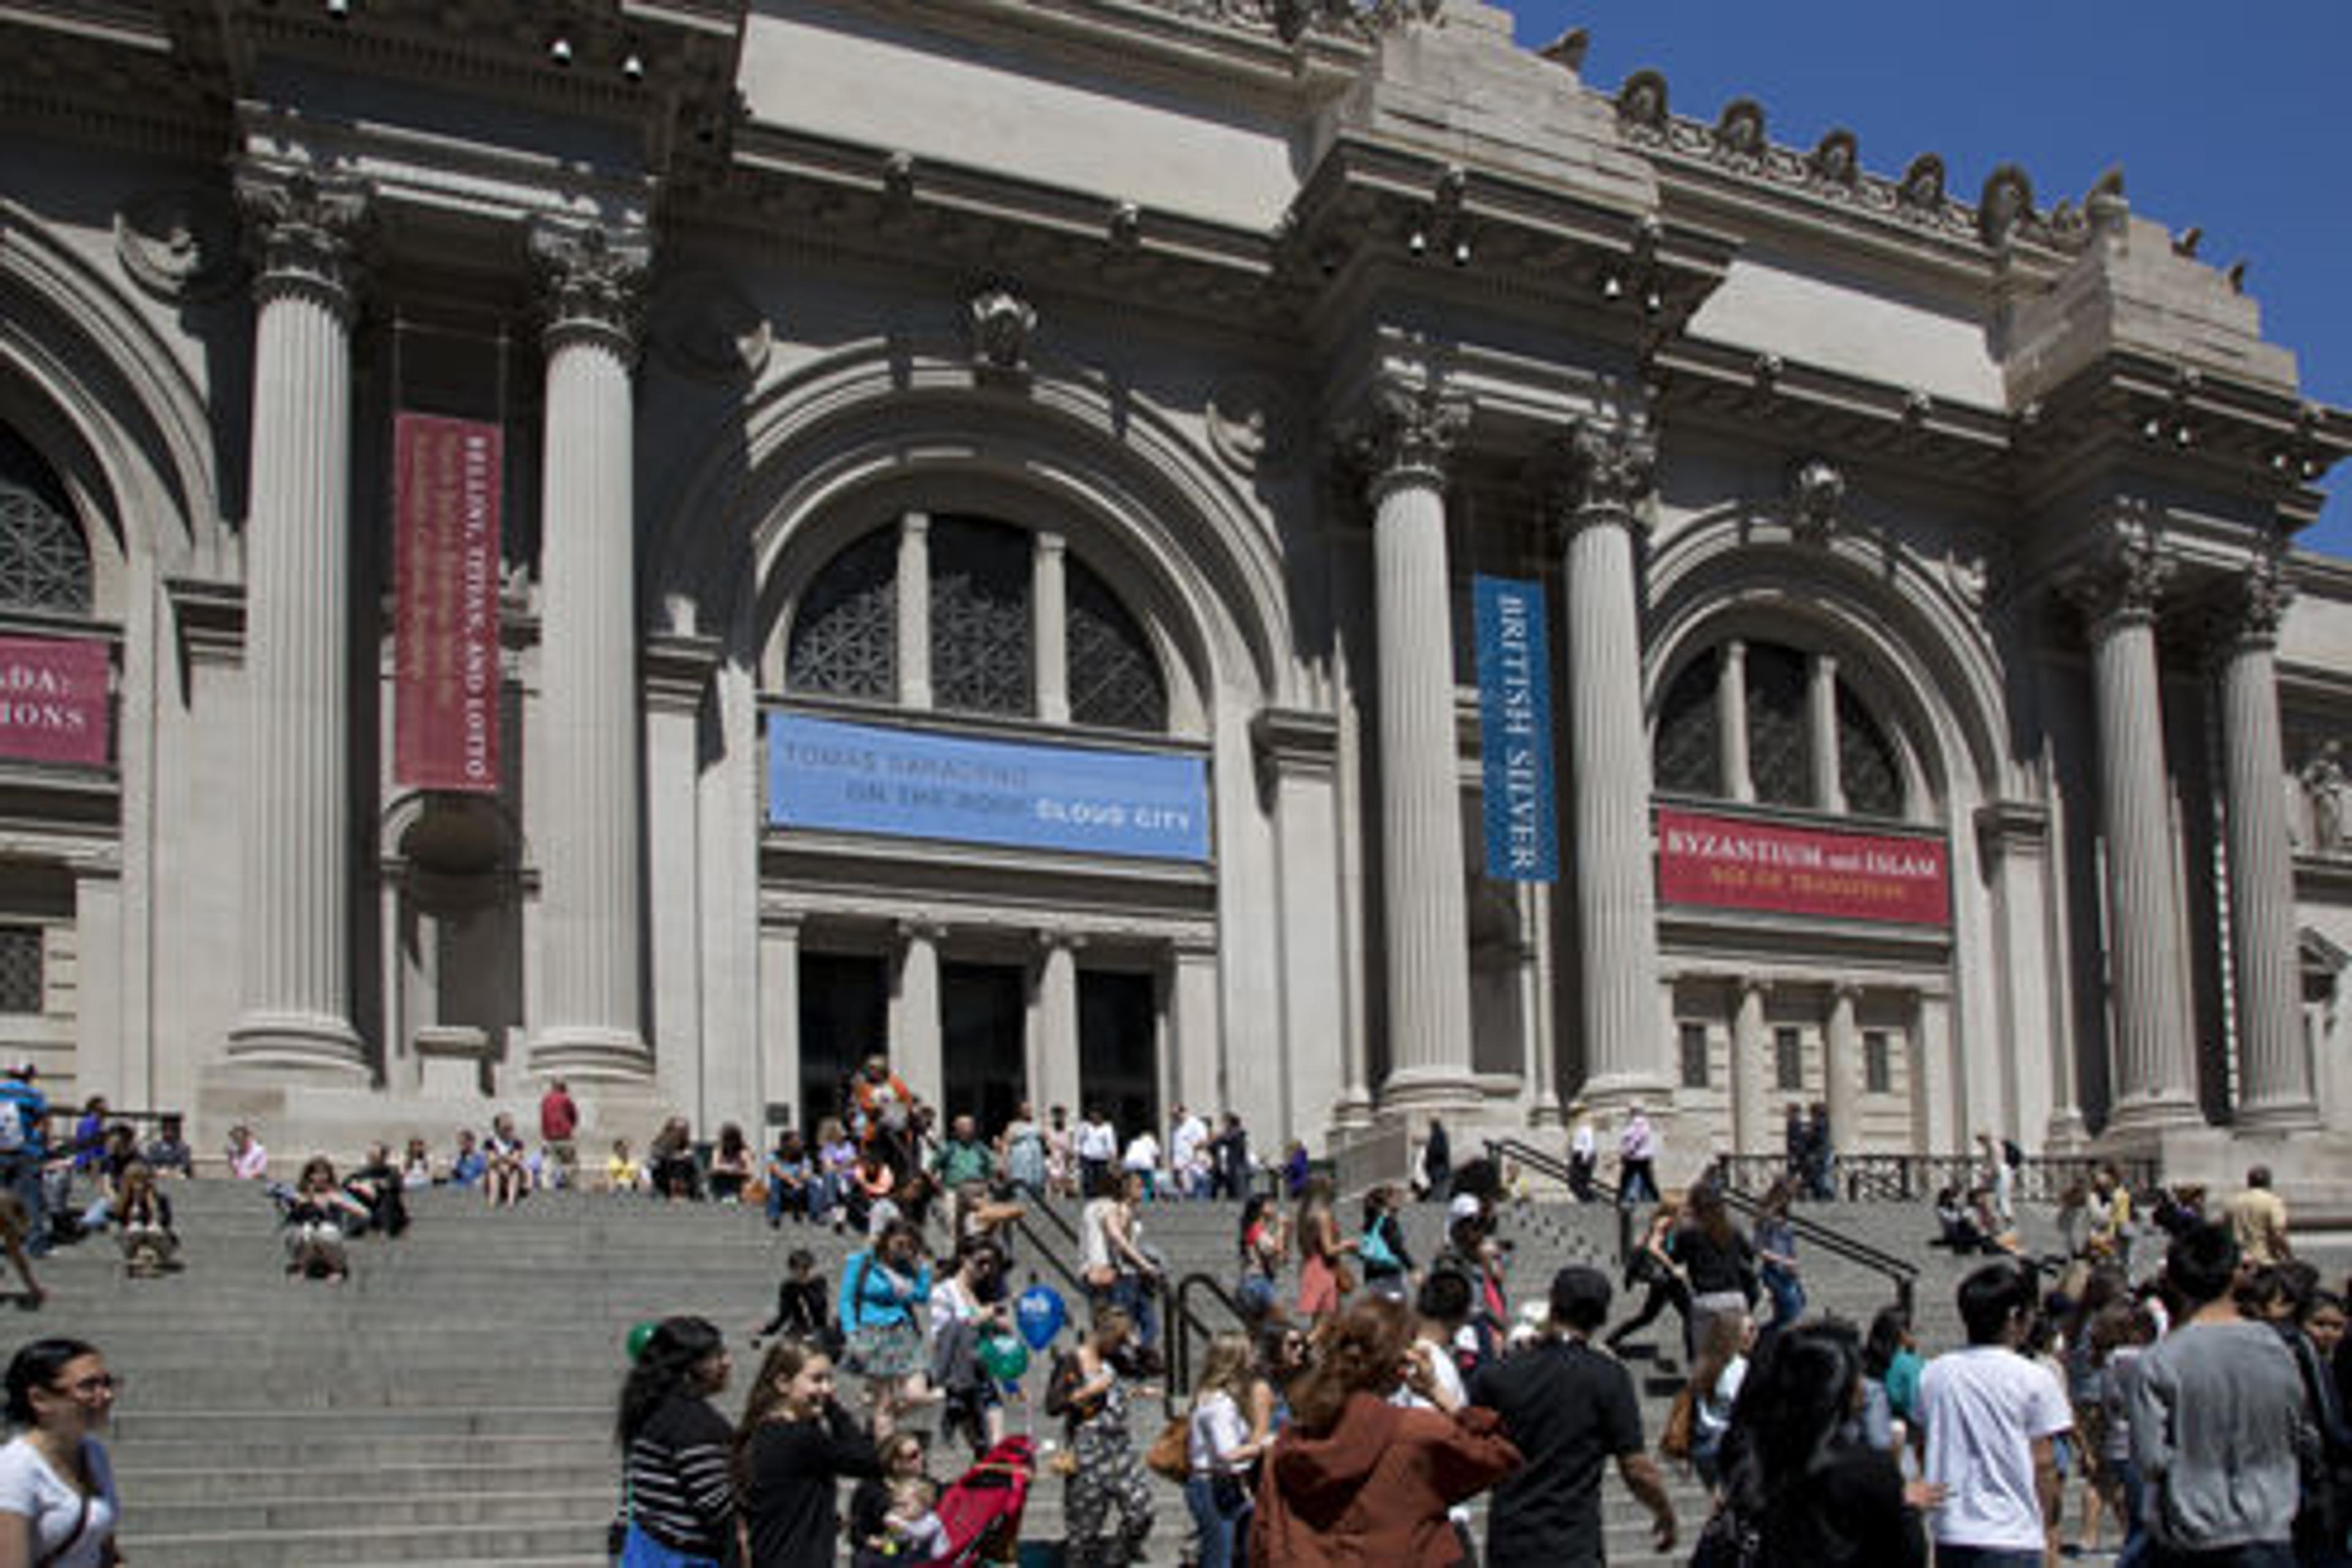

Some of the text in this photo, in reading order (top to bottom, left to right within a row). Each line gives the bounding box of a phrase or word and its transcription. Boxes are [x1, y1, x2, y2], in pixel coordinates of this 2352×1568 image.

[466, 641, 486, 693] AND
[466, 697, 486, 777] LOTTO
[1499, 594, 1536, 870] BRITISH SILVER
[1134, 804, 1191, 833] CITY
[1667, 828, 1823, 868] BYZANTIUM
[1865, 851, 1939, 878] ISLAM
